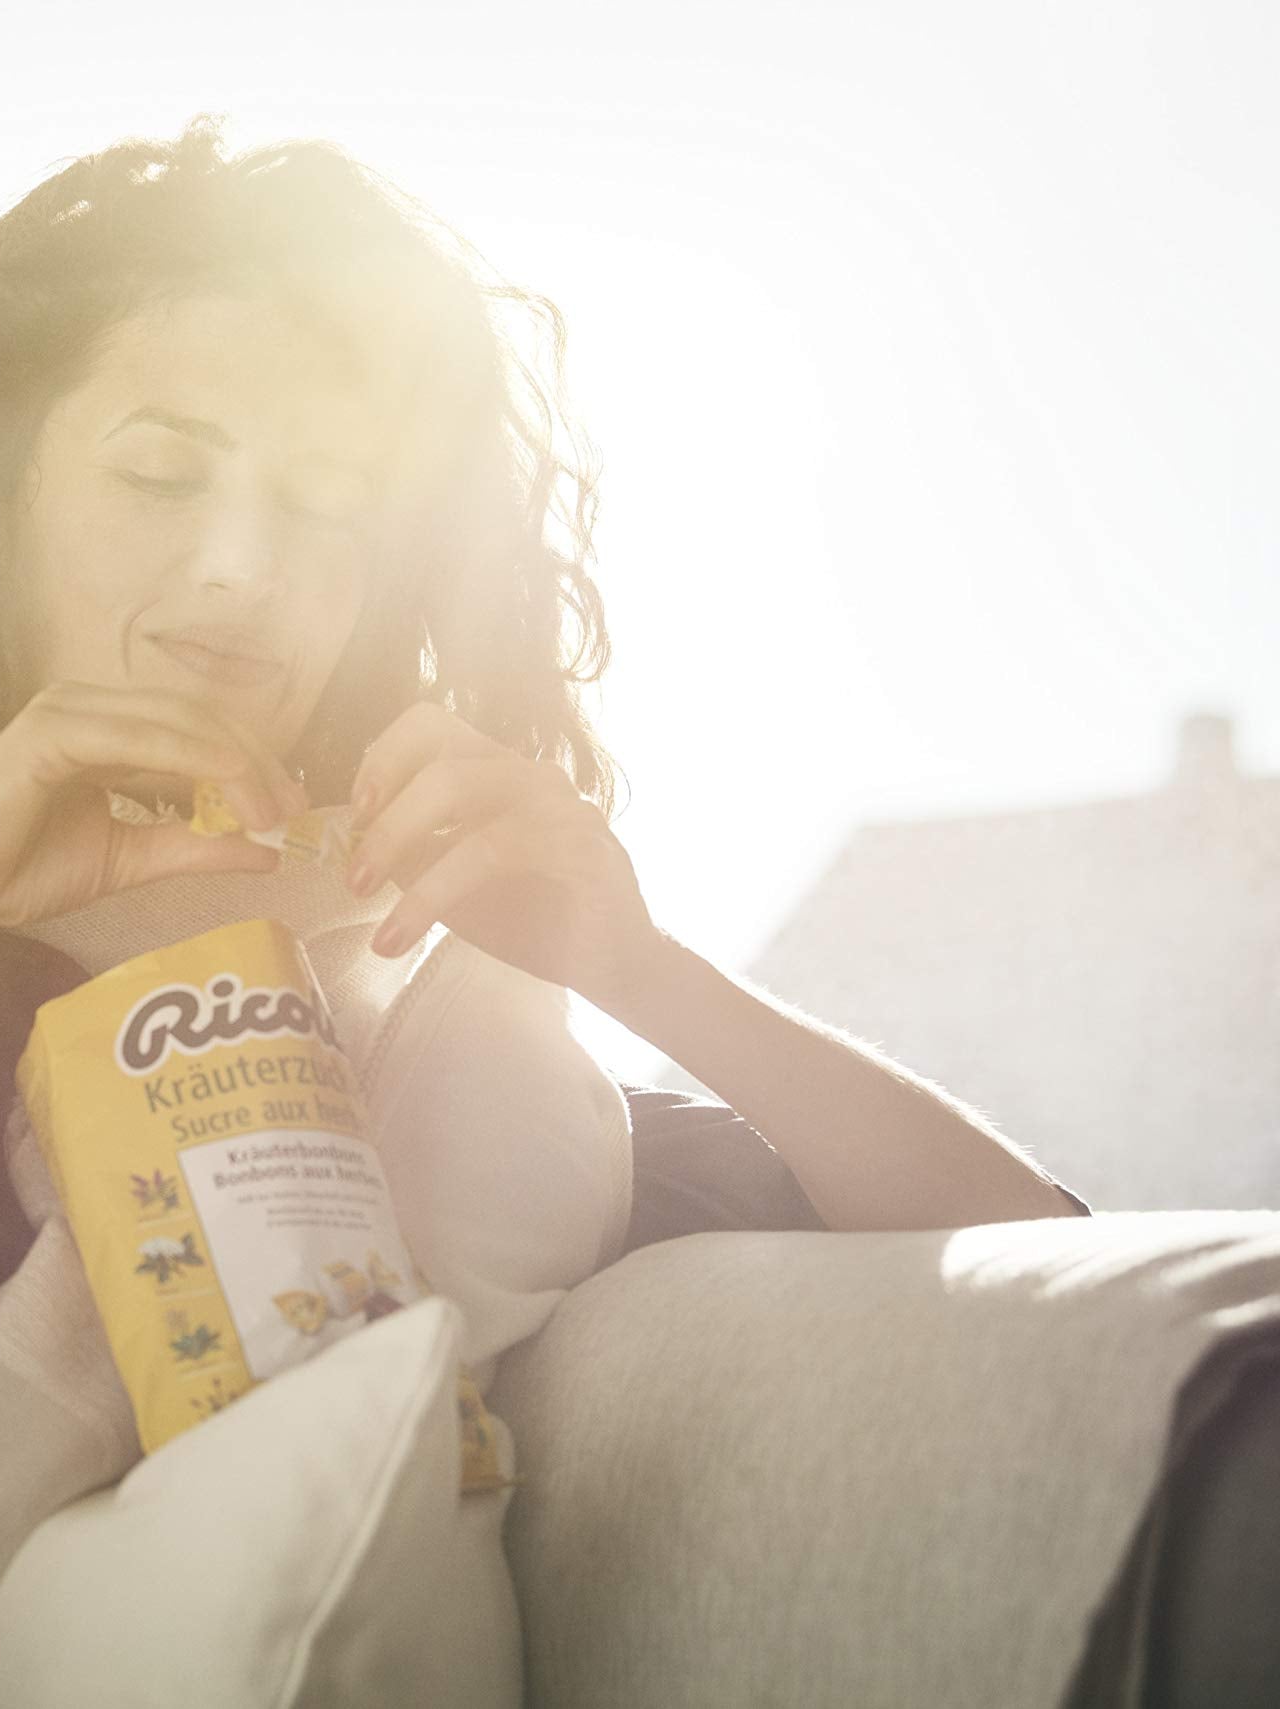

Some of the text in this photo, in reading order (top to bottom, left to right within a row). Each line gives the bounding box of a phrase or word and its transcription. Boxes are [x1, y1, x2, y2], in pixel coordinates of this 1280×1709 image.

[122, 979, 338, 1071] Ricol
[173, 1104, 251, 1144] Sucre
[263, 1098, 309, 1123] aux
[213, 1165, 297, 1190] Bonbons
[302, 1166, 332, 1180] aux
